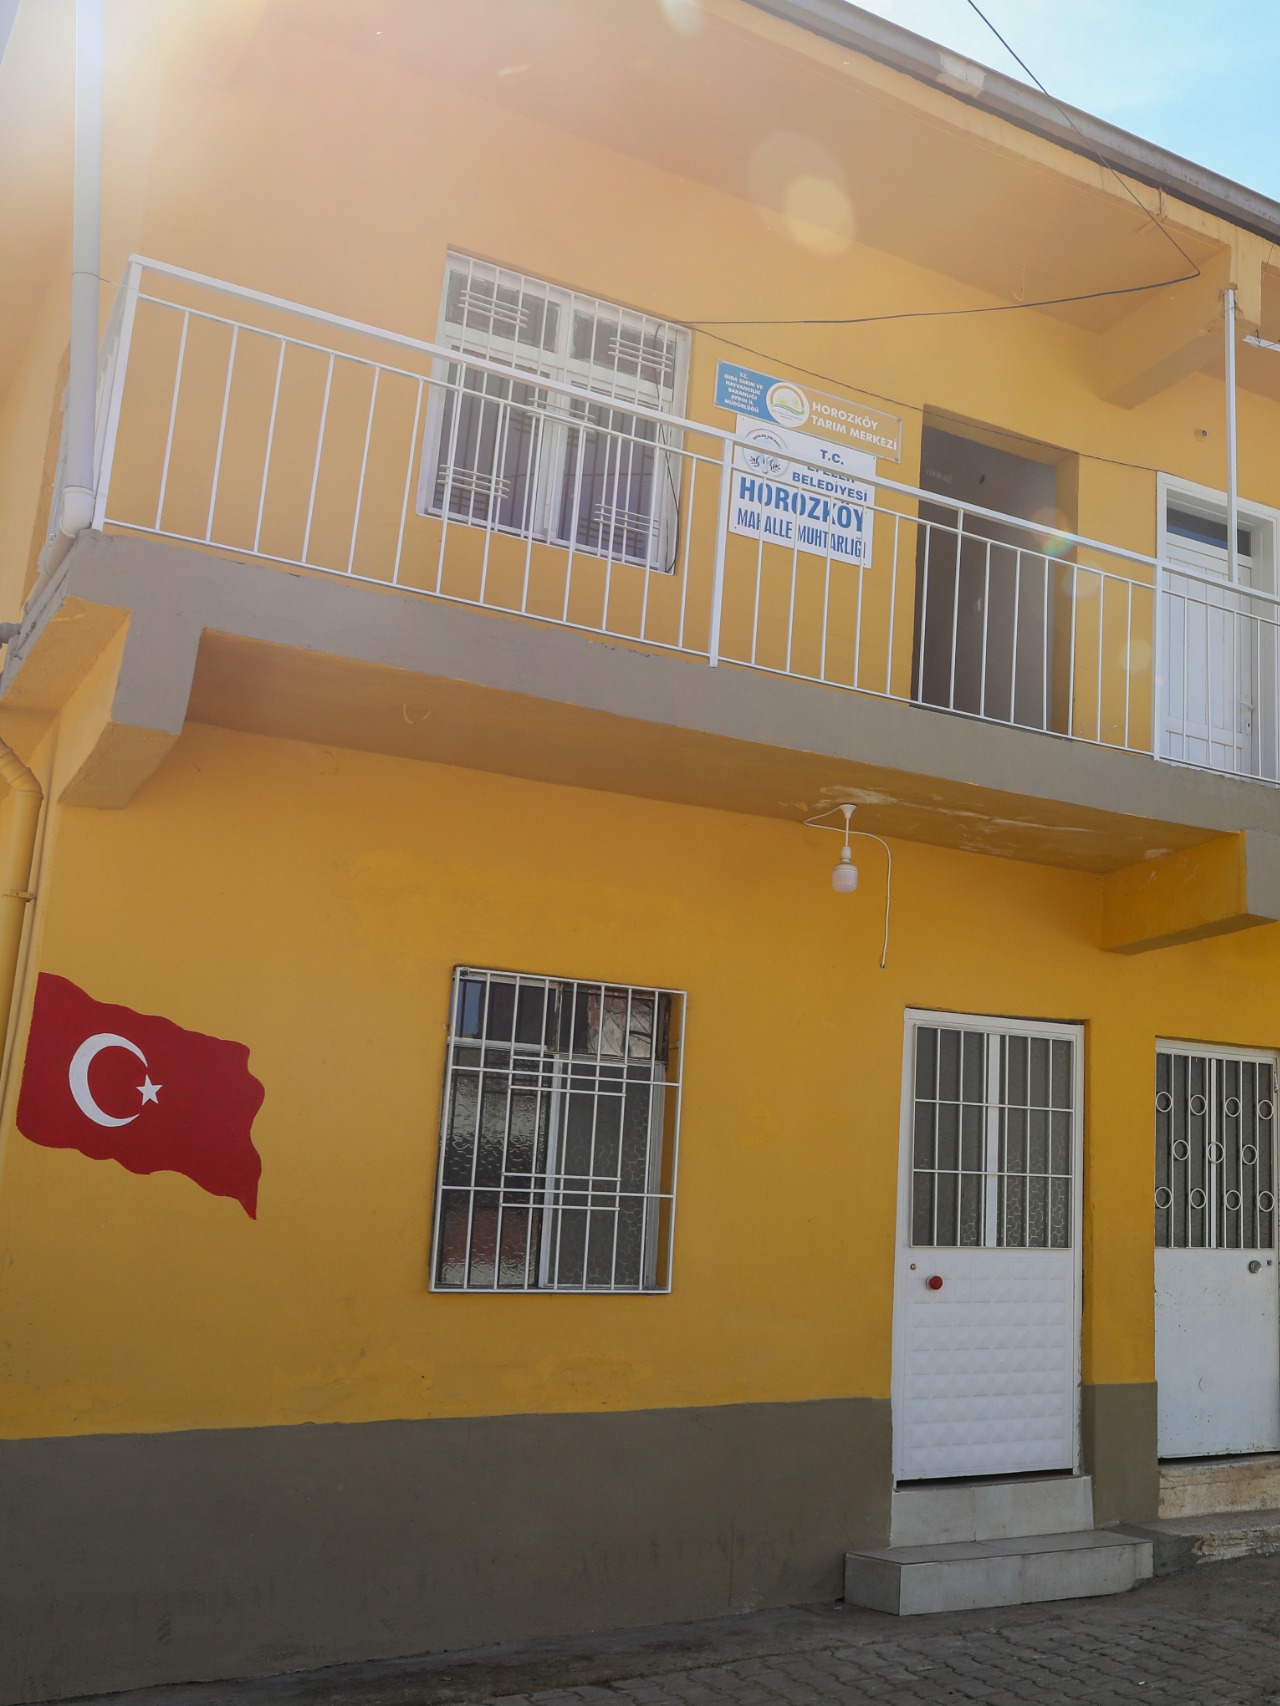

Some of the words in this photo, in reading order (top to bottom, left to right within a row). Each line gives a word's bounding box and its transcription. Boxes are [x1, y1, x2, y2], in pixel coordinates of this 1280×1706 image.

[725, 380, 761, 395] HAYVANCILIK
[739, 378, 755, 387] TARIM
[812, 401, 879, 430] HOROZKÖY
[811, 415, 847, 434] TARIM
[849, 427, 897, 451] MERKEZİ
[819, 449, 844, 465] T.C.
[792, 472, 867, 501] BELEDİYESİ
[740, 477, 864, 532] HOROZKÖY
[798, 524, 866, 558] MUHTARLIĞI
